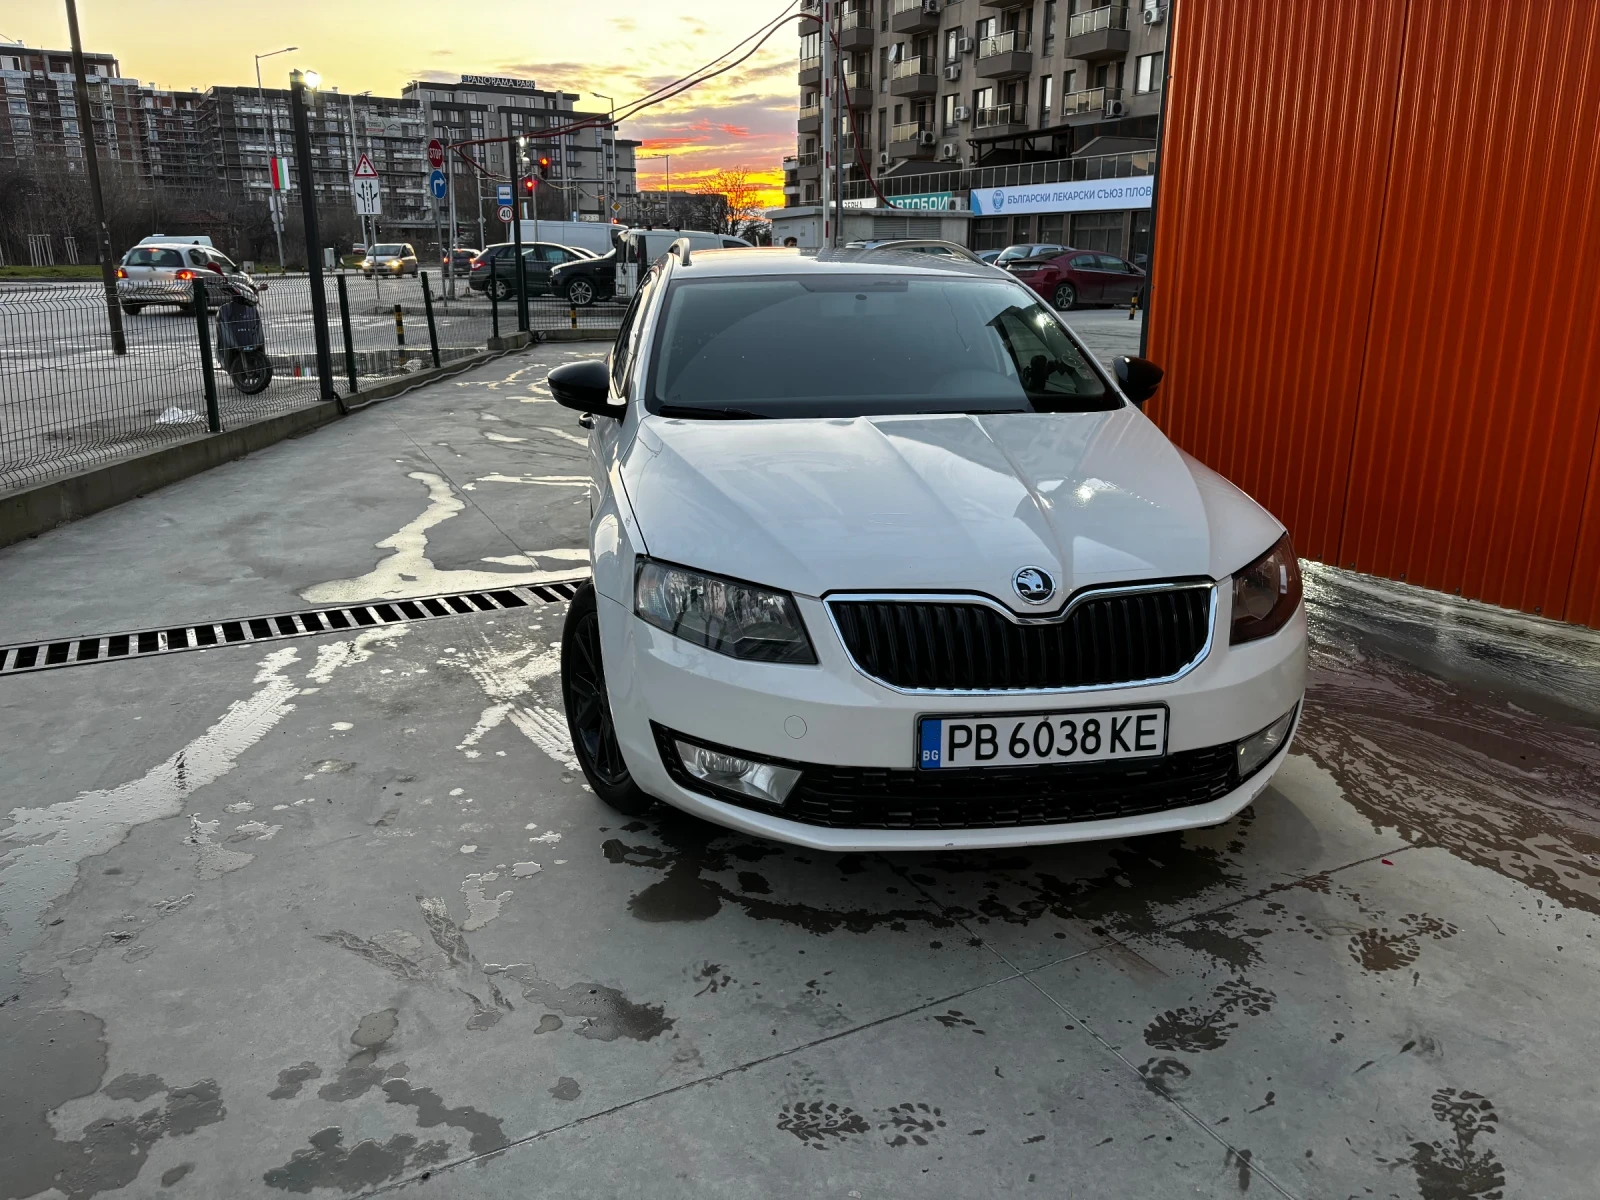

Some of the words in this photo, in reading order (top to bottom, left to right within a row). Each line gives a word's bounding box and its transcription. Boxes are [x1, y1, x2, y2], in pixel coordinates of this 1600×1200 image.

[467, 75, 514, 86] PANORAMA
[516, 79, 536, 88] PARK
[429, 147, 442, 159] STOP
[1007, 193, 1051, 204] БЪЛГАРСКИ
[1052, 189, 1095, 202] ЛЕКАРСКИ
[1097, 187, 1123, 199] СЪЮЗ
[501, 209, 511, 218] 40
[948, 723, 999, 762] PB
[1008, 718, 1101, 759] 6038
[1109, 714, 1158, 753] KE
[922, 750, 939, 761] BG
